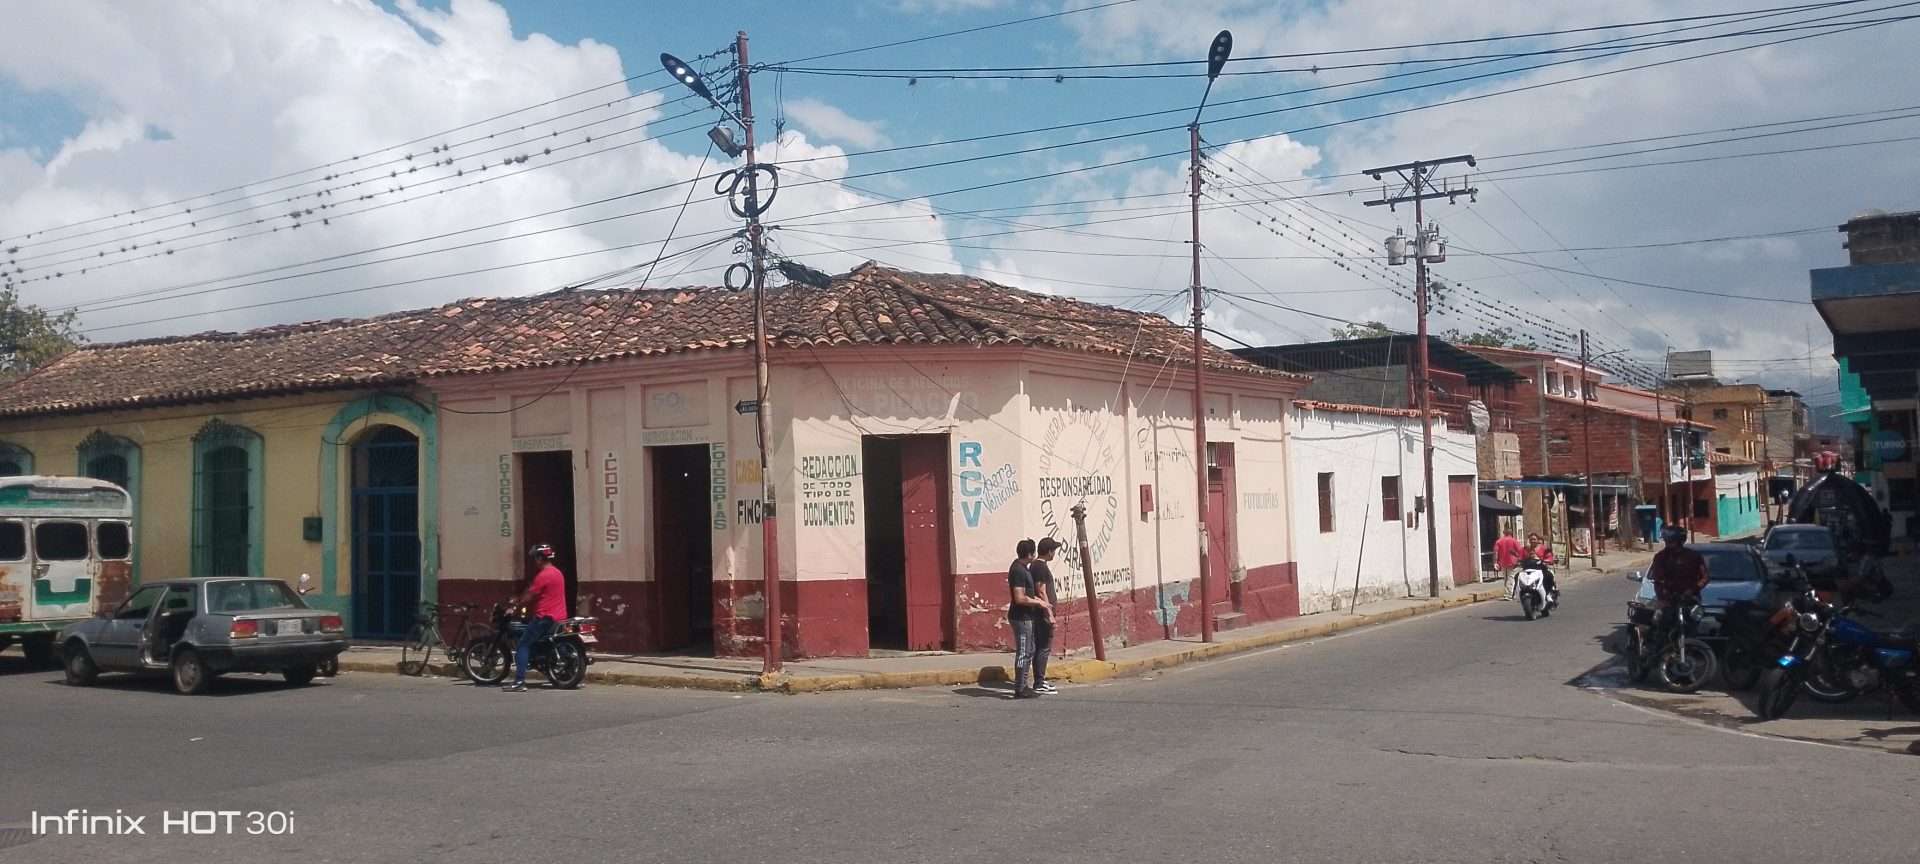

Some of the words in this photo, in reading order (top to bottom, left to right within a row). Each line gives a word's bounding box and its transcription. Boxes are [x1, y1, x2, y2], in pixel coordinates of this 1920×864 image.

[802, 454, 857, 479] REDACCION
[499, 454, 511, 537] FOTOCOPIAS
[711, 442, 727, 530] FOTOCOPIAS
[802, 482, 816, 490] DE
[820, 481, 852, 489] TODO
[803, 490, 831, 498] TIPO
[959, 441, 982, 528] RCV
[1039, 475, 1112, 498] RESPONSABILIDAD
[737, 499, 764, 525] FINC
[803, 500, 855, 526] DOCUMENTOS
[1101, 567, 1130, 586] DOCUMENTOS
